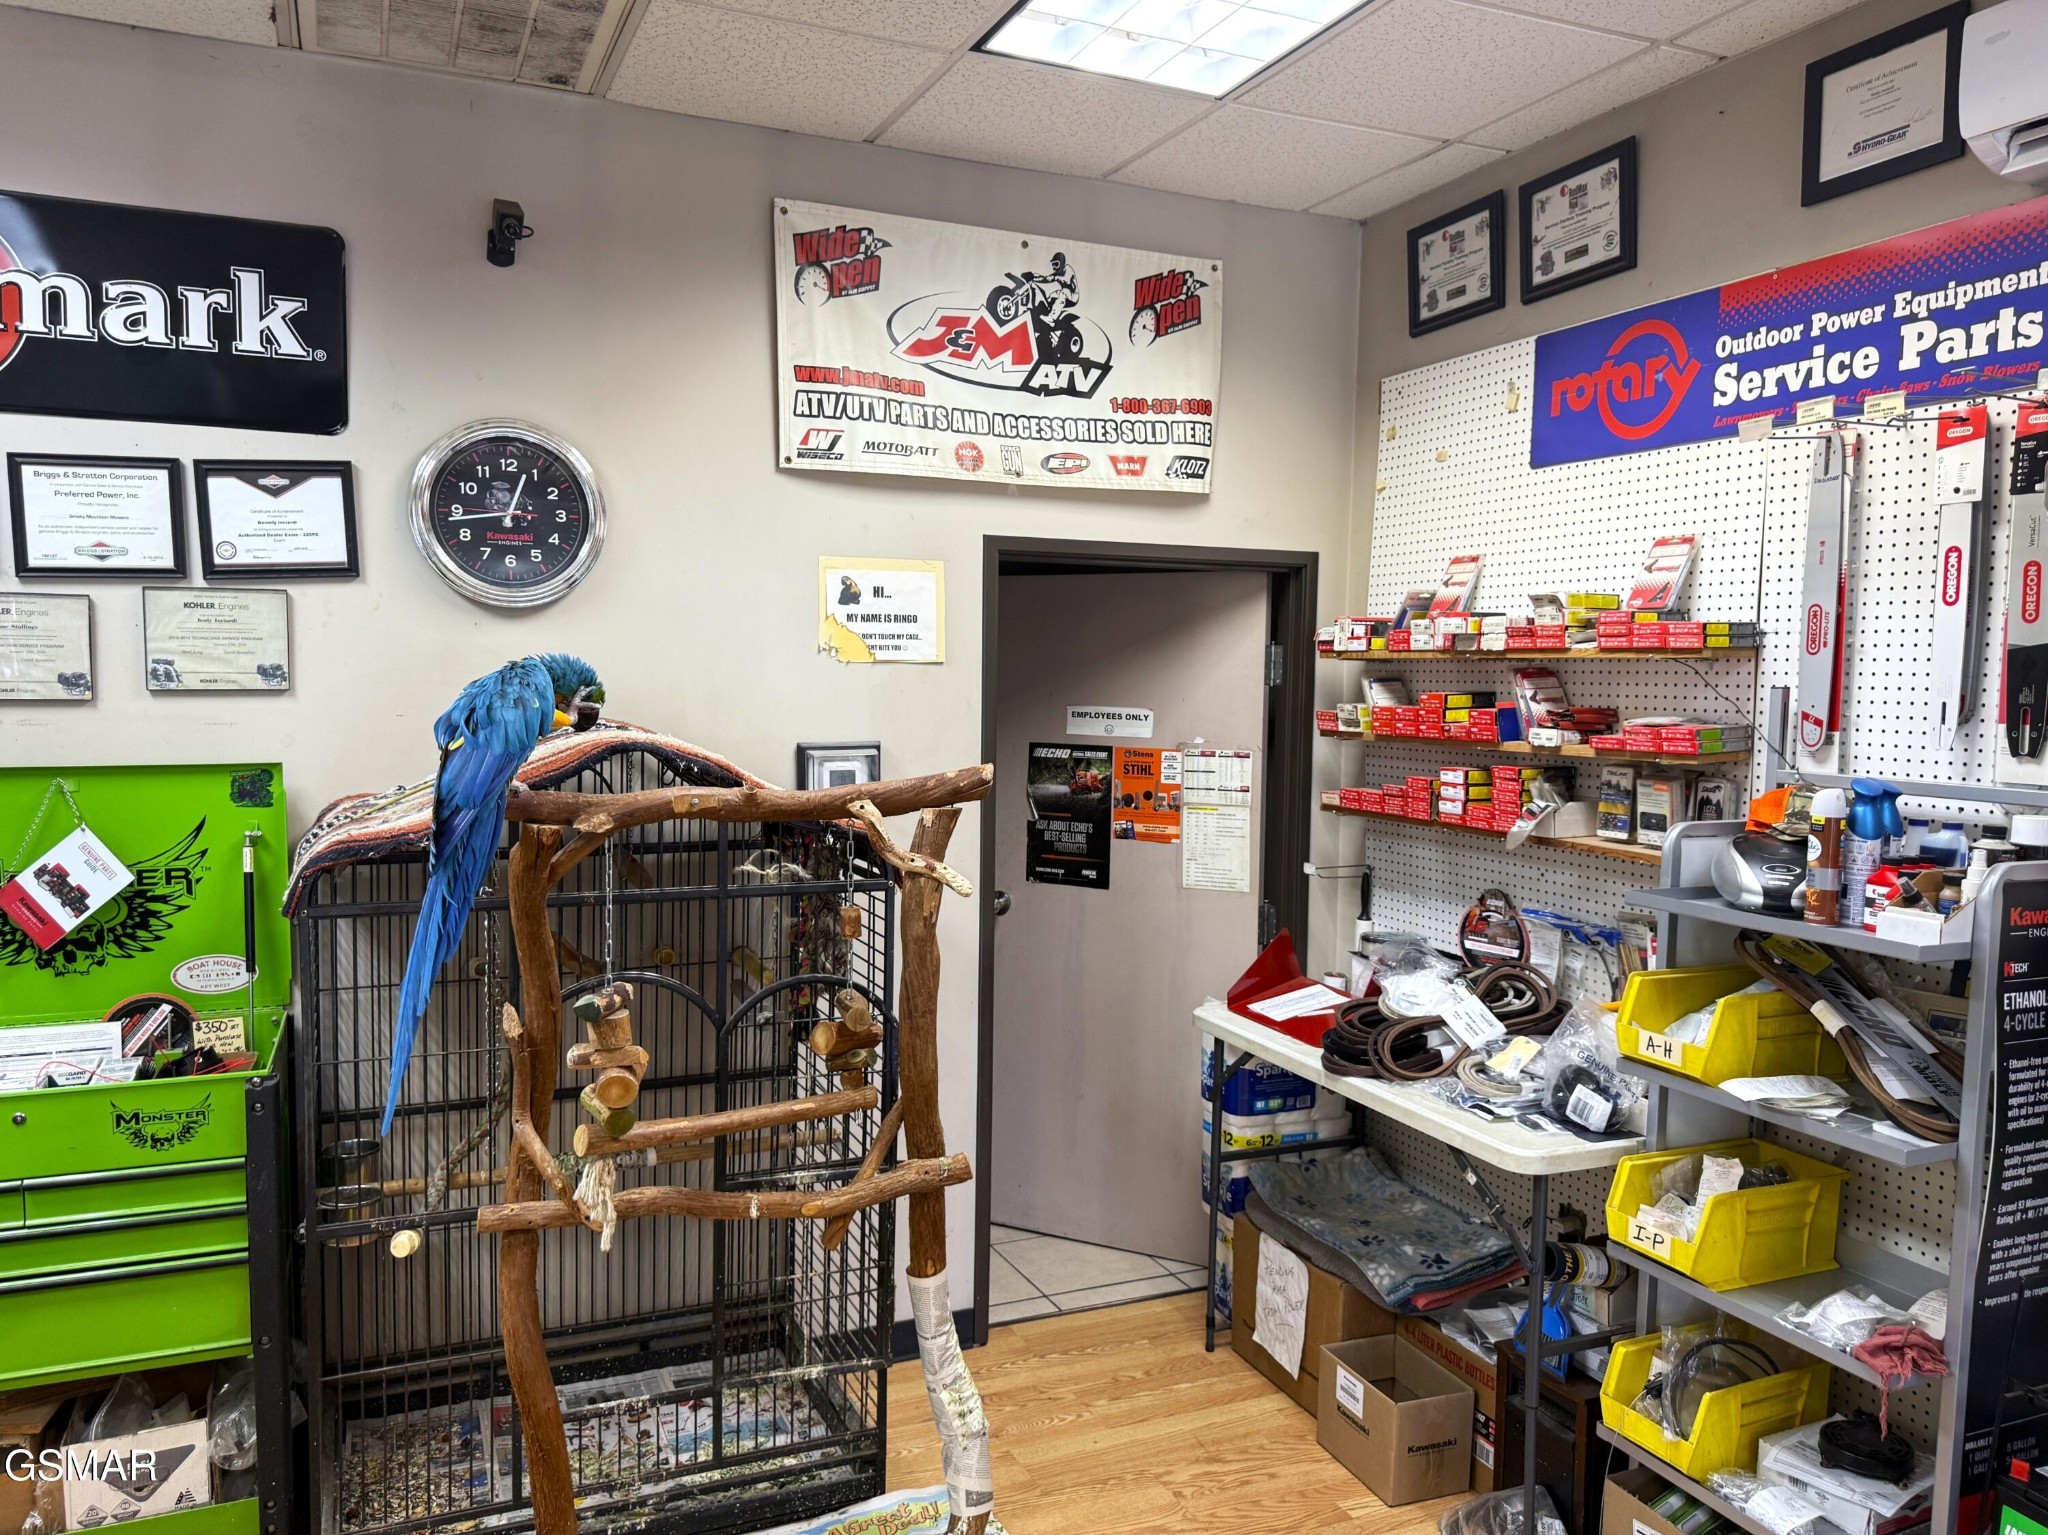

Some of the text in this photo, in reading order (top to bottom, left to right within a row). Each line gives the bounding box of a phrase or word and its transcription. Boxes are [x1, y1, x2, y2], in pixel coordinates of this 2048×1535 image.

[1861, 131, 1907, 152] HYDRO-GEAR
[794, 226, 860, 266] Wide
[1134, 269, 1185, 310] Wide
[1716, 261, 2048, 359] Outdoor Power Equipment
[902, 315, 1035, 367] J&M
[1712, 307, 2044, 408] Service Parts
[794, 365, 925, 397] www.jmatv.com
[1028, 363, 1102, 393] ATV
[1900, 361, 2042, 395] Saws Snow Blowers
[1110, 397, 1212, 416] 1-800-367-6903
[794, 390, 1212, 447] ATV/UTV PARTS AND ACCESSORIES SOLD HERE
[1948, 428, 1971, 436] OREGON
[796, 451, 844, 461] WISECO
[862, 441, 940, 457] MOTOBATT
[958, 449, 979, 457] NGK
[500, 458, 518, 472] 12
[1002, 450, 1023, 472] GUN
[1048, 458, 1089, 469] EPI
[1116, 462, 1141, 470] WARN
[1174, 458, 1206, 474] KLOTZ
[33, 470, 62, 480] Briggs
[72, 472, 108, 480] Stratton
[110, 472, 158, 482] Corporation
[476, 466, 490, 478] 11
[532, 469, 538, 481] 1
[54, 490, 95, 498] Preferred
[126, 492, 141, 500] Inc.
[459, 482, 478, 494] 10
[547, 488, 558, 500] 2
[451, 505, 463, 517] 9
[555, 510, 566, 522] 3
[460, 528, 471, 541] 8
[486, 531, 534, 541] Kawasaki
[548, 533, 560, 546] 4
[480, 548, 491, 560] 7
[505, 555, 516, 567] 6
[530, 550, 542, 562] 5
[1945, 550, 1960, 602] OREGON
[2025, 564, 2038, 620] OREGON
[15, 608, 49, 616] Engines
[184, 602, 250, 611] KOHLER Engines
[846, 613, 918, 624] MY NAME IS RINGO
[1809, 607, 1819, 651] OREGON
[891, 644, 902, 652] YOU
[1071, 710, 1150, 722] EMPLOYEES ONLY
[1040, 748, 1072, 758] ECHO
[1132, 750, 1154, 758] Stens
[1123, 764, 1154, 776] STIHL
[1036, 820, 1094, 834] ASK ABOUT ECHO'S
[1044, 830, 1086, 844] BEST-SELLING
[1054, 842, 1087, 854] PRODUCTS
[82, 844, 115, 878] GENUINE PARTS
[83, 858, 99, 874] GUIDE
[18, 897, 48, 927] Kawasaki
[186, 960, 244, 972] BOAT HOUSE
[2004, 1011, 2046, 1033] 4-CYCLE
[1646, 1038, 1673, 1060] A-H
[1577, 1050, 1618, 1082] GENUINE
[2009, 1057, 2042, 1070] Ethanol-free
[2008, 1069, 2038, 1082] formulated
[2008, 1080, 2040, 1094] durability of
[2008, 1094, 2028, 1106] engines
[2008, 1108, 2020, 1118] with
[2028, 1105, 2034, 1114] to
[116, 1110, 207, 1130] MONSTER
[2007, 1115, 2045, 1130] specifications)
[1222, 1130, 1234, 1146] 12
[1260, 1134, 1274, 1148] 12
[2005, 1140, 2035, 1154] Formulated
[2004, 1155, 2022, 1168] quality
[2002, 1166, 2026, 1178] reducing
[2001, 1176, 2032, 1192] aggravation
[1998, 1203, 2017, 1214] Earned
[1996, 1214, 2014, 1226] Rating
[1633, 1224, 1664, 1251] I-P
[1992, 1232, 2040, 1249] Enables long-term
[1991, 1250, 2003, 1260] with
[2008, 1246, 2022, 1257] shelf
[1264, 1255, 1294, 1279] PENDING
[1989, 1262, 2004, 1274] years
[2032, 1253, 2041, 1264] and
[1988, 1270, 2018, 1286] years after
[1984, 1294, 2010, 1306] Improves
[1418, 1332, 1436, 1354] LITER
[1436, 1342, 1464, 1370] PLASTIC
[1464, 1360, 1495, 1392] BOTTLES
[1337, 1403, 1370, 1437] Kawasaki
[1407, 1438, 1457, 1455] Kawasaki
[1964, 1437, 1989, 1450] AVAILABLE
[2012, 1436, 2036, 1451] GALLON
[844, 1502, 912, 1535] Great
[878, 1500, 942, 1535] Deal!
